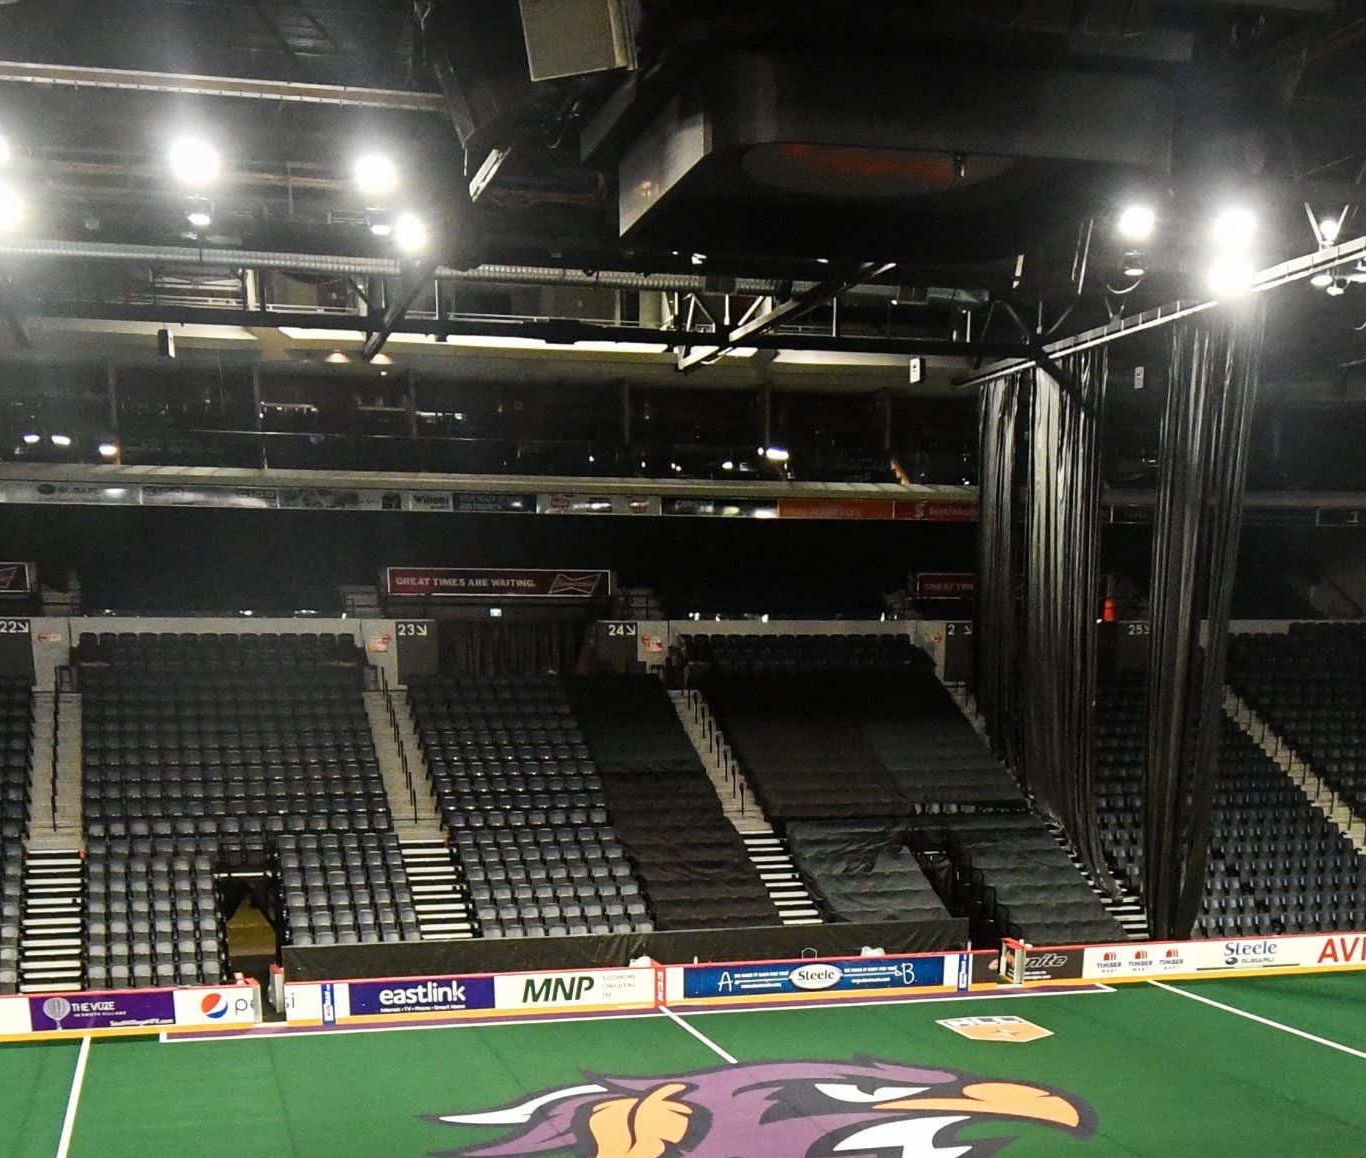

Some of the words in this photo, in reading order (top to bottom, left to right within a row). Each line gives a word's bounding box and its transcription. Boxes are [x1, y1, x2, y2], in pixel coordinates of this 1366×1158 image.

[396, 577, 431, 586] GREAT
[432, 578, 465, 587] TIMES
[467, 578, 490, 588] ARE
[491, 579, 537, 588] WAITING.
[398, 624, 415, 636] 23
[608, 624, 624, 636] 24
[1128, 624, 1143, 635] 25
[1223, 941, 1278, 956] Steele
[717, 971, 733, 992] A
[798, 970, 835, 981] Steele
[379, 980, 466, 1005] eastlink
[522, 976, 595, 1003] MNP
